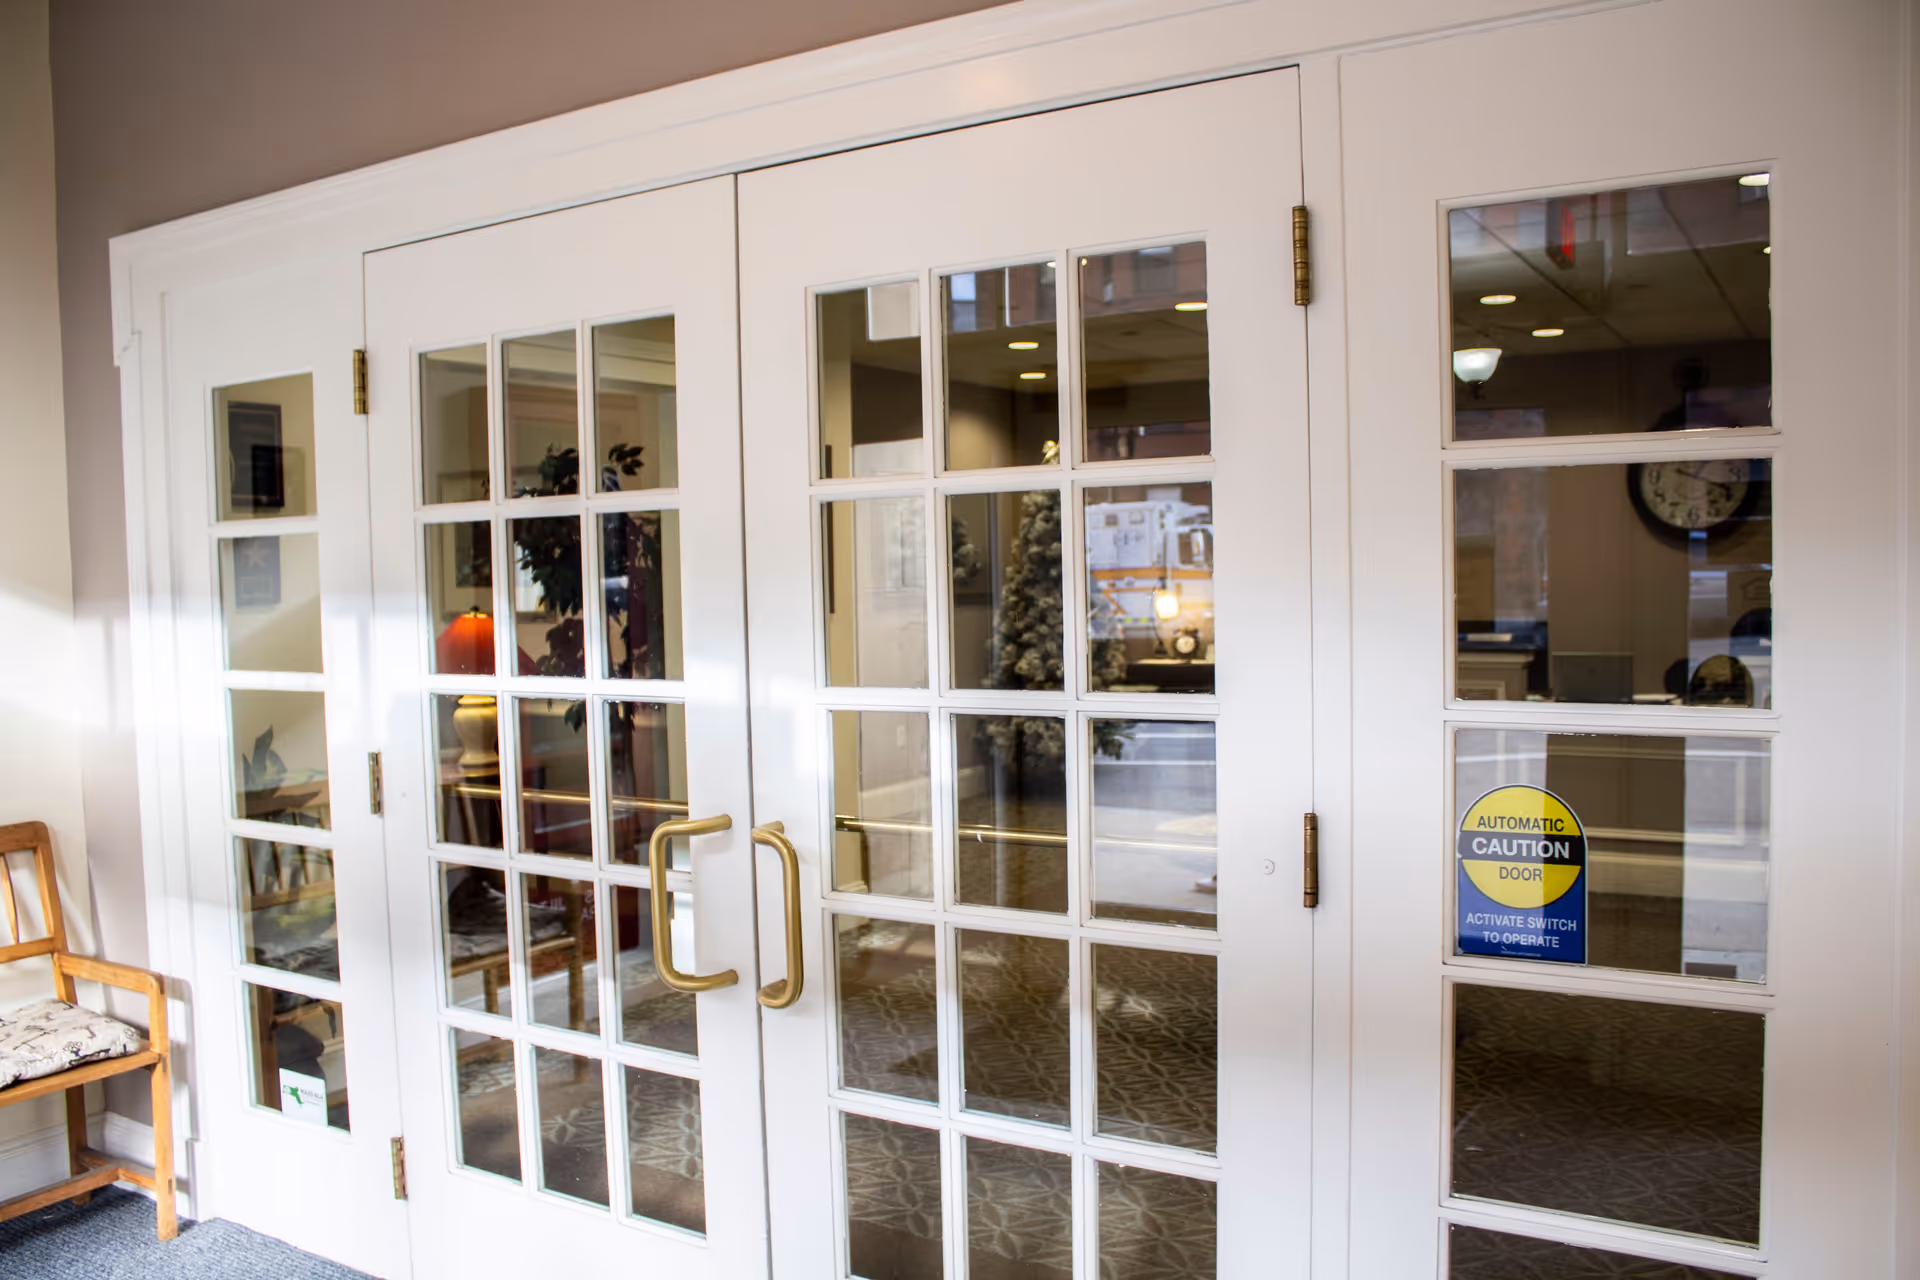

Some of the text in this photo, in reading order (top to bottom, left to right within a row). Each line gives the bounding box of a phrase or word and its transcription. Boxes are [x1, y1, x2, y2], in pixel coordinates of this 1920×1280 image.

[1477, 816, 1565, 832] AUTOMATIC
[1472, 837, 1569, 858] CAUTION
[1499, 866, 1543, 881] DOOR
[1466, 913, 1577, 931] ACTIVATE SWITCH
[1483, 931, 1560, 948] TO OPERATE
